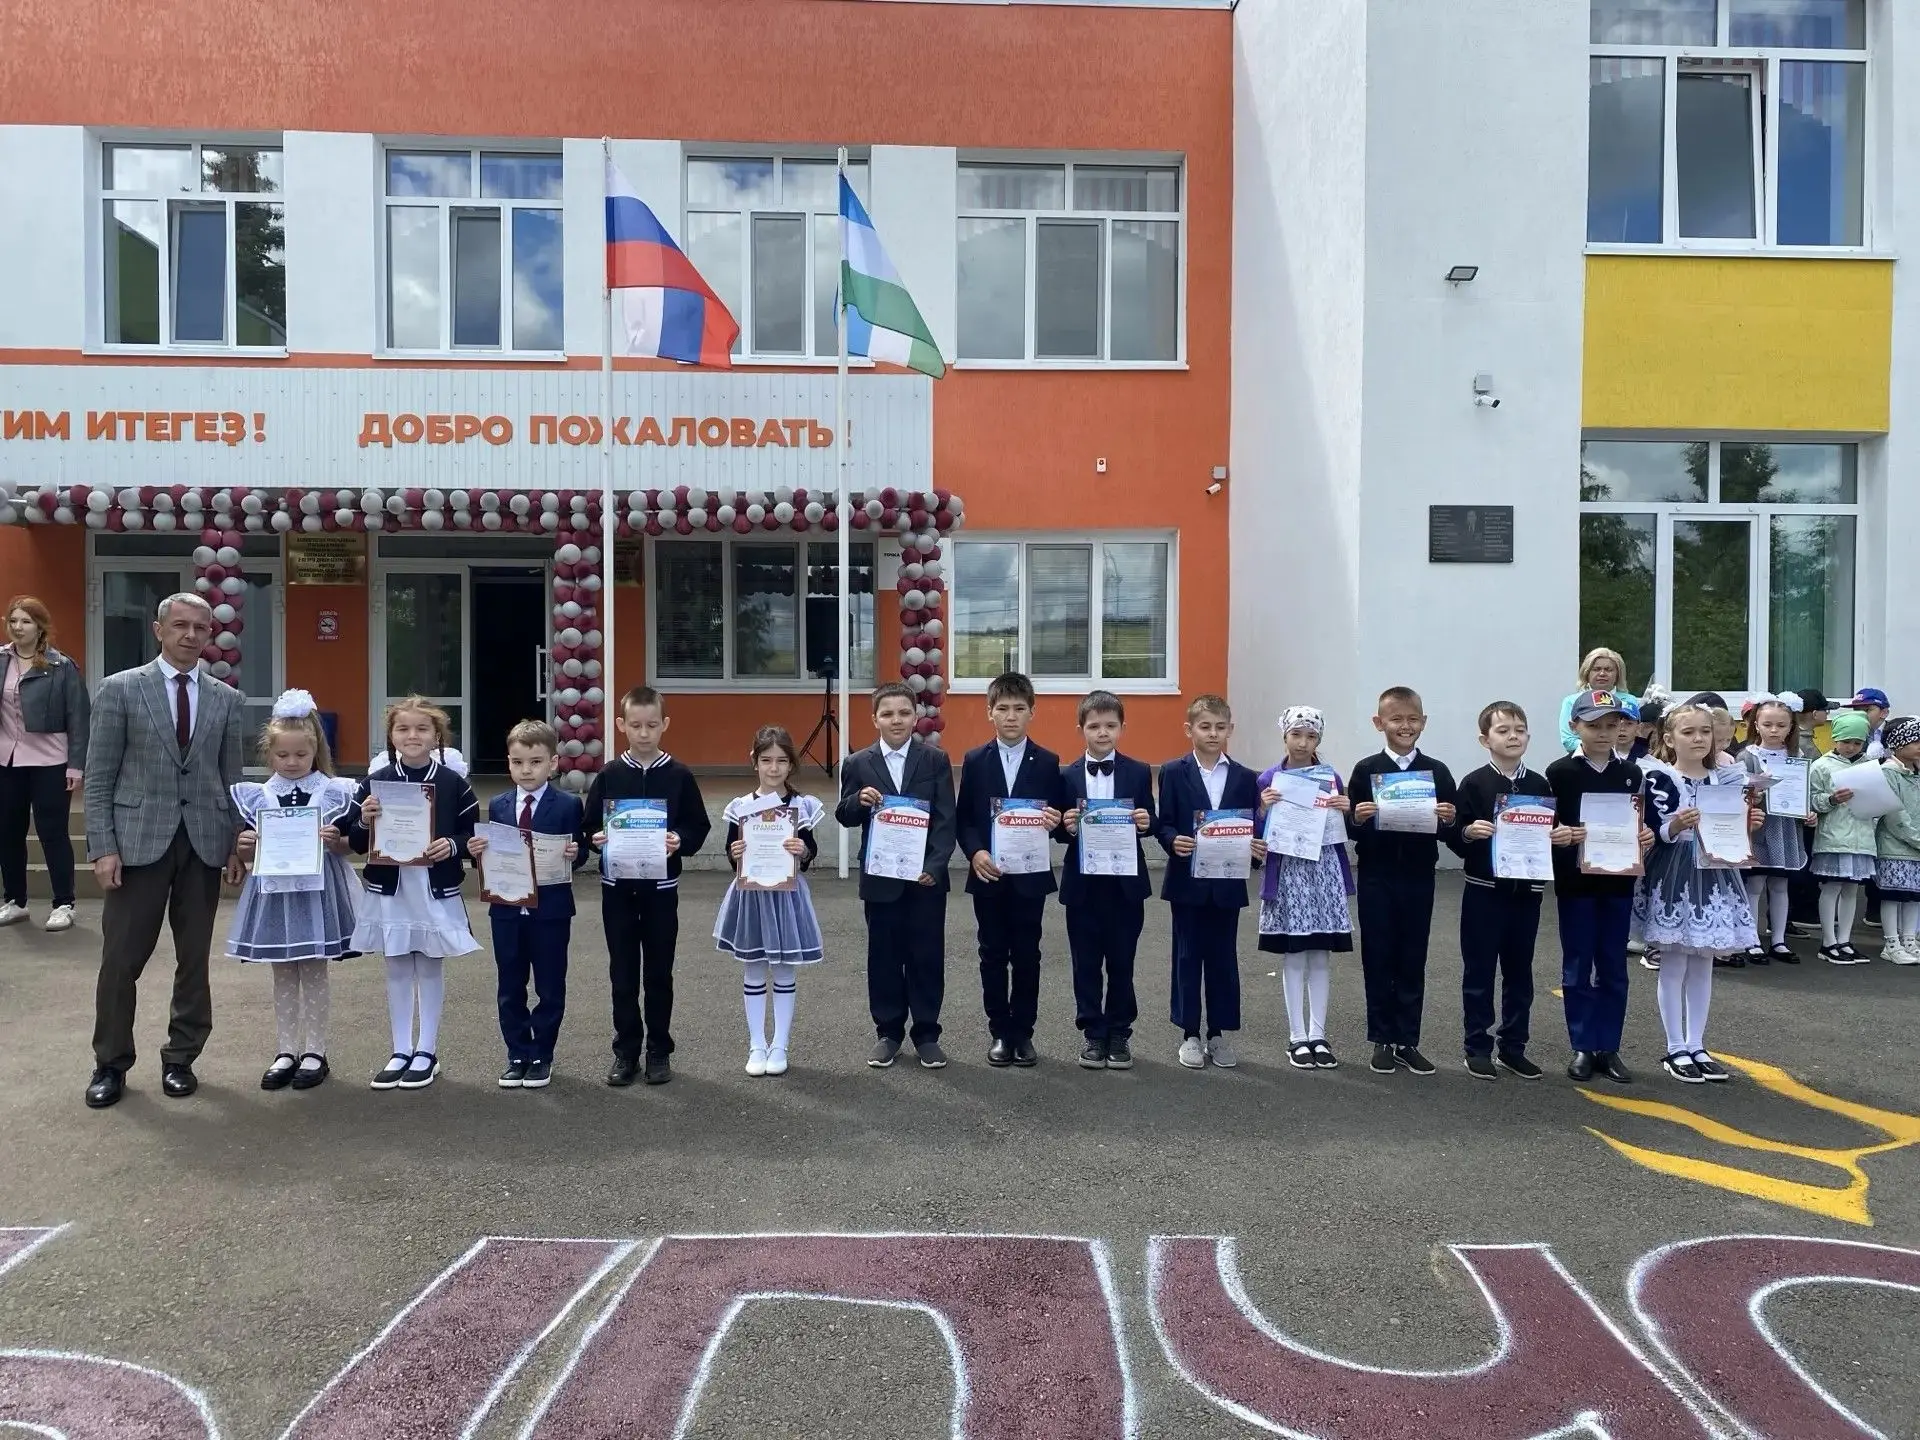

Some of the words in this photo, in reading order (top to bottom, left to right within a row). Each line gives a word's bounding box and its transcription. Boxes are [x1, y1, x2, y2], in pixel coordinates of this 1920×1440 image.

[0, 410, 70, 440] ИМ
[359, 413, 513, 448] ДОБРО
[529, 415, 852, 449] ПОЖАЛОВАТЬ
[889, 815, 926, 826] ДИПЛОМ
[1512, 814, 1552, 824] ДИПЛОМ
[1212, 827, 1251, 836] ДИПЛОМ
